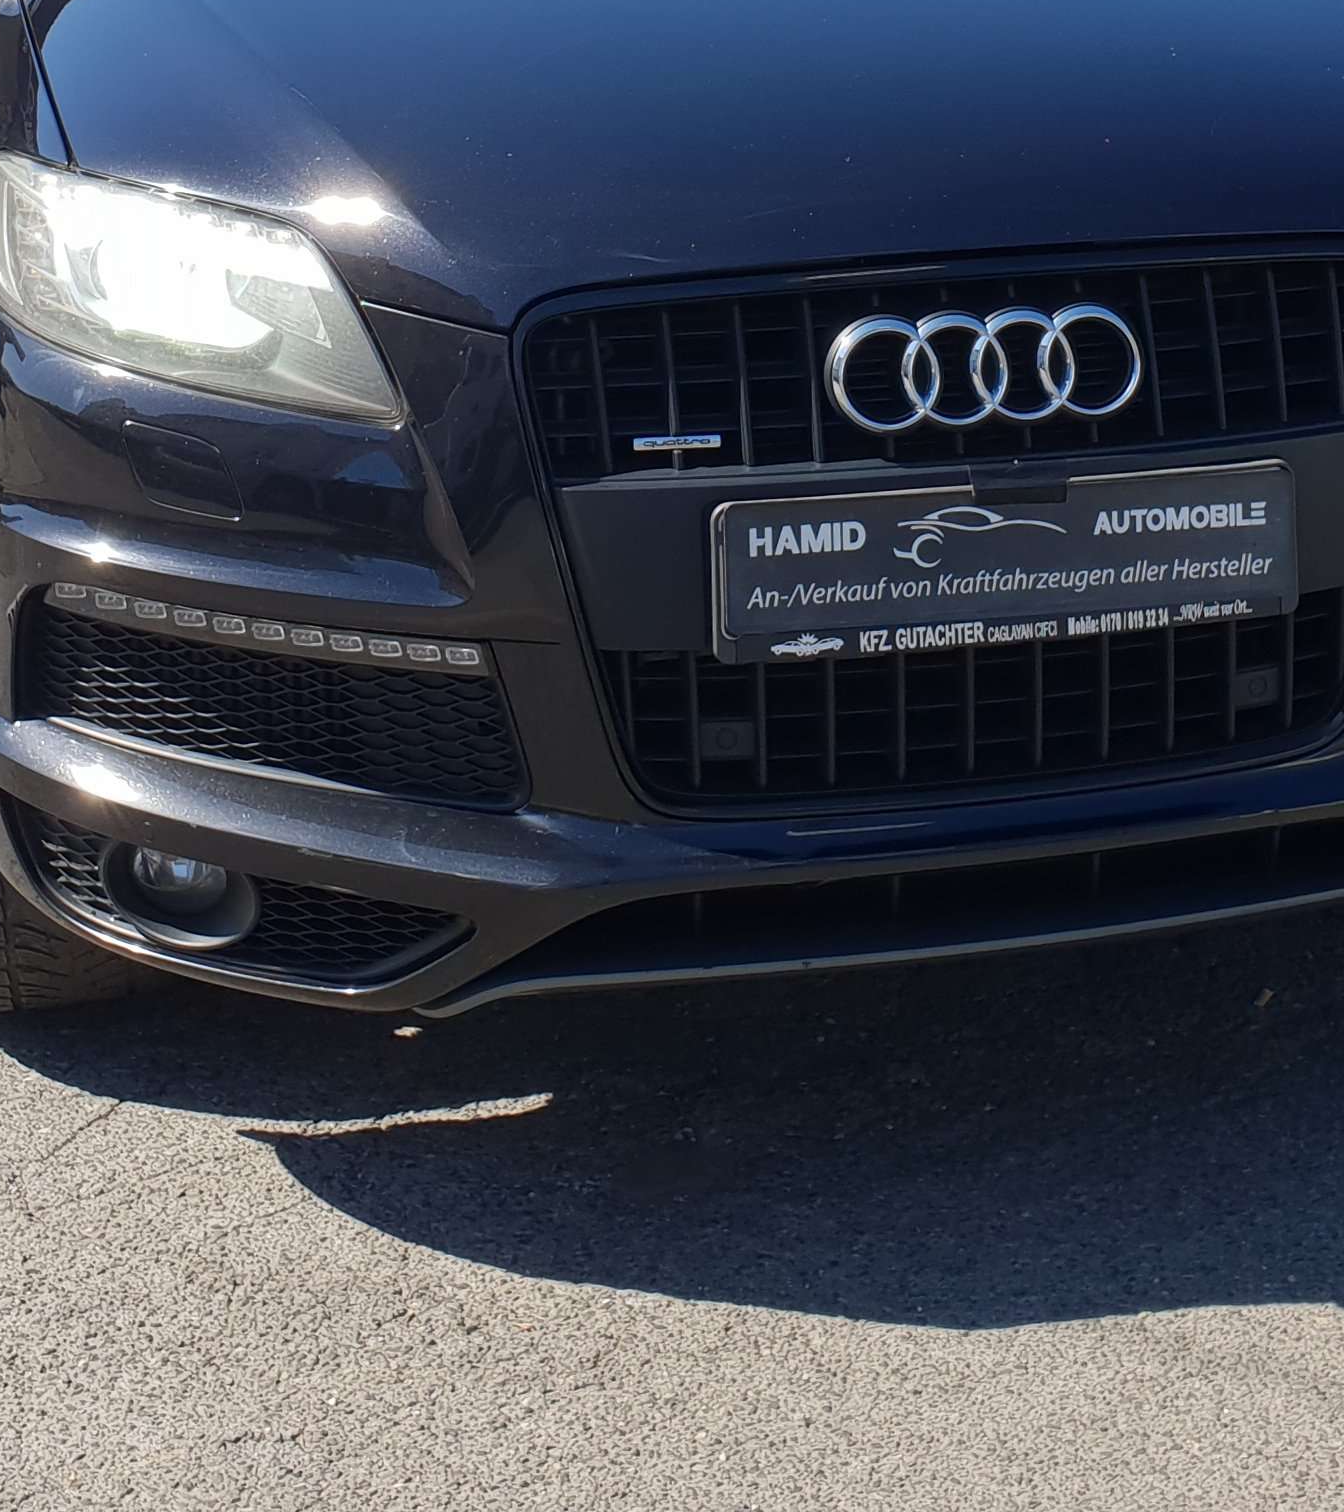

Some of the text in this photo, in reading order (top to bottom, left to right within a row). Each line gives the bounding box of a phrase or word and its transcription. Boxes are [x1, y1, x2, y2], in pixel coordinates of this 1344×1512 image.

[643, 438, 711, 448] quattro
[749, 501, 1266, 558] HAMID AUTOMOBILE
[747, 553, 1273, 611] An-/Verkauf von Kraftfahrzeugen aller Hersteller
[895, 621, 984, 650] GUTACHTER
[987, 623, 1034, 643] CAGLAYAN
[1100, 612, 1121, 632] 0170
[1145, 608, 1156, 628] 32
[1158, 607, 1169, 627] 34
